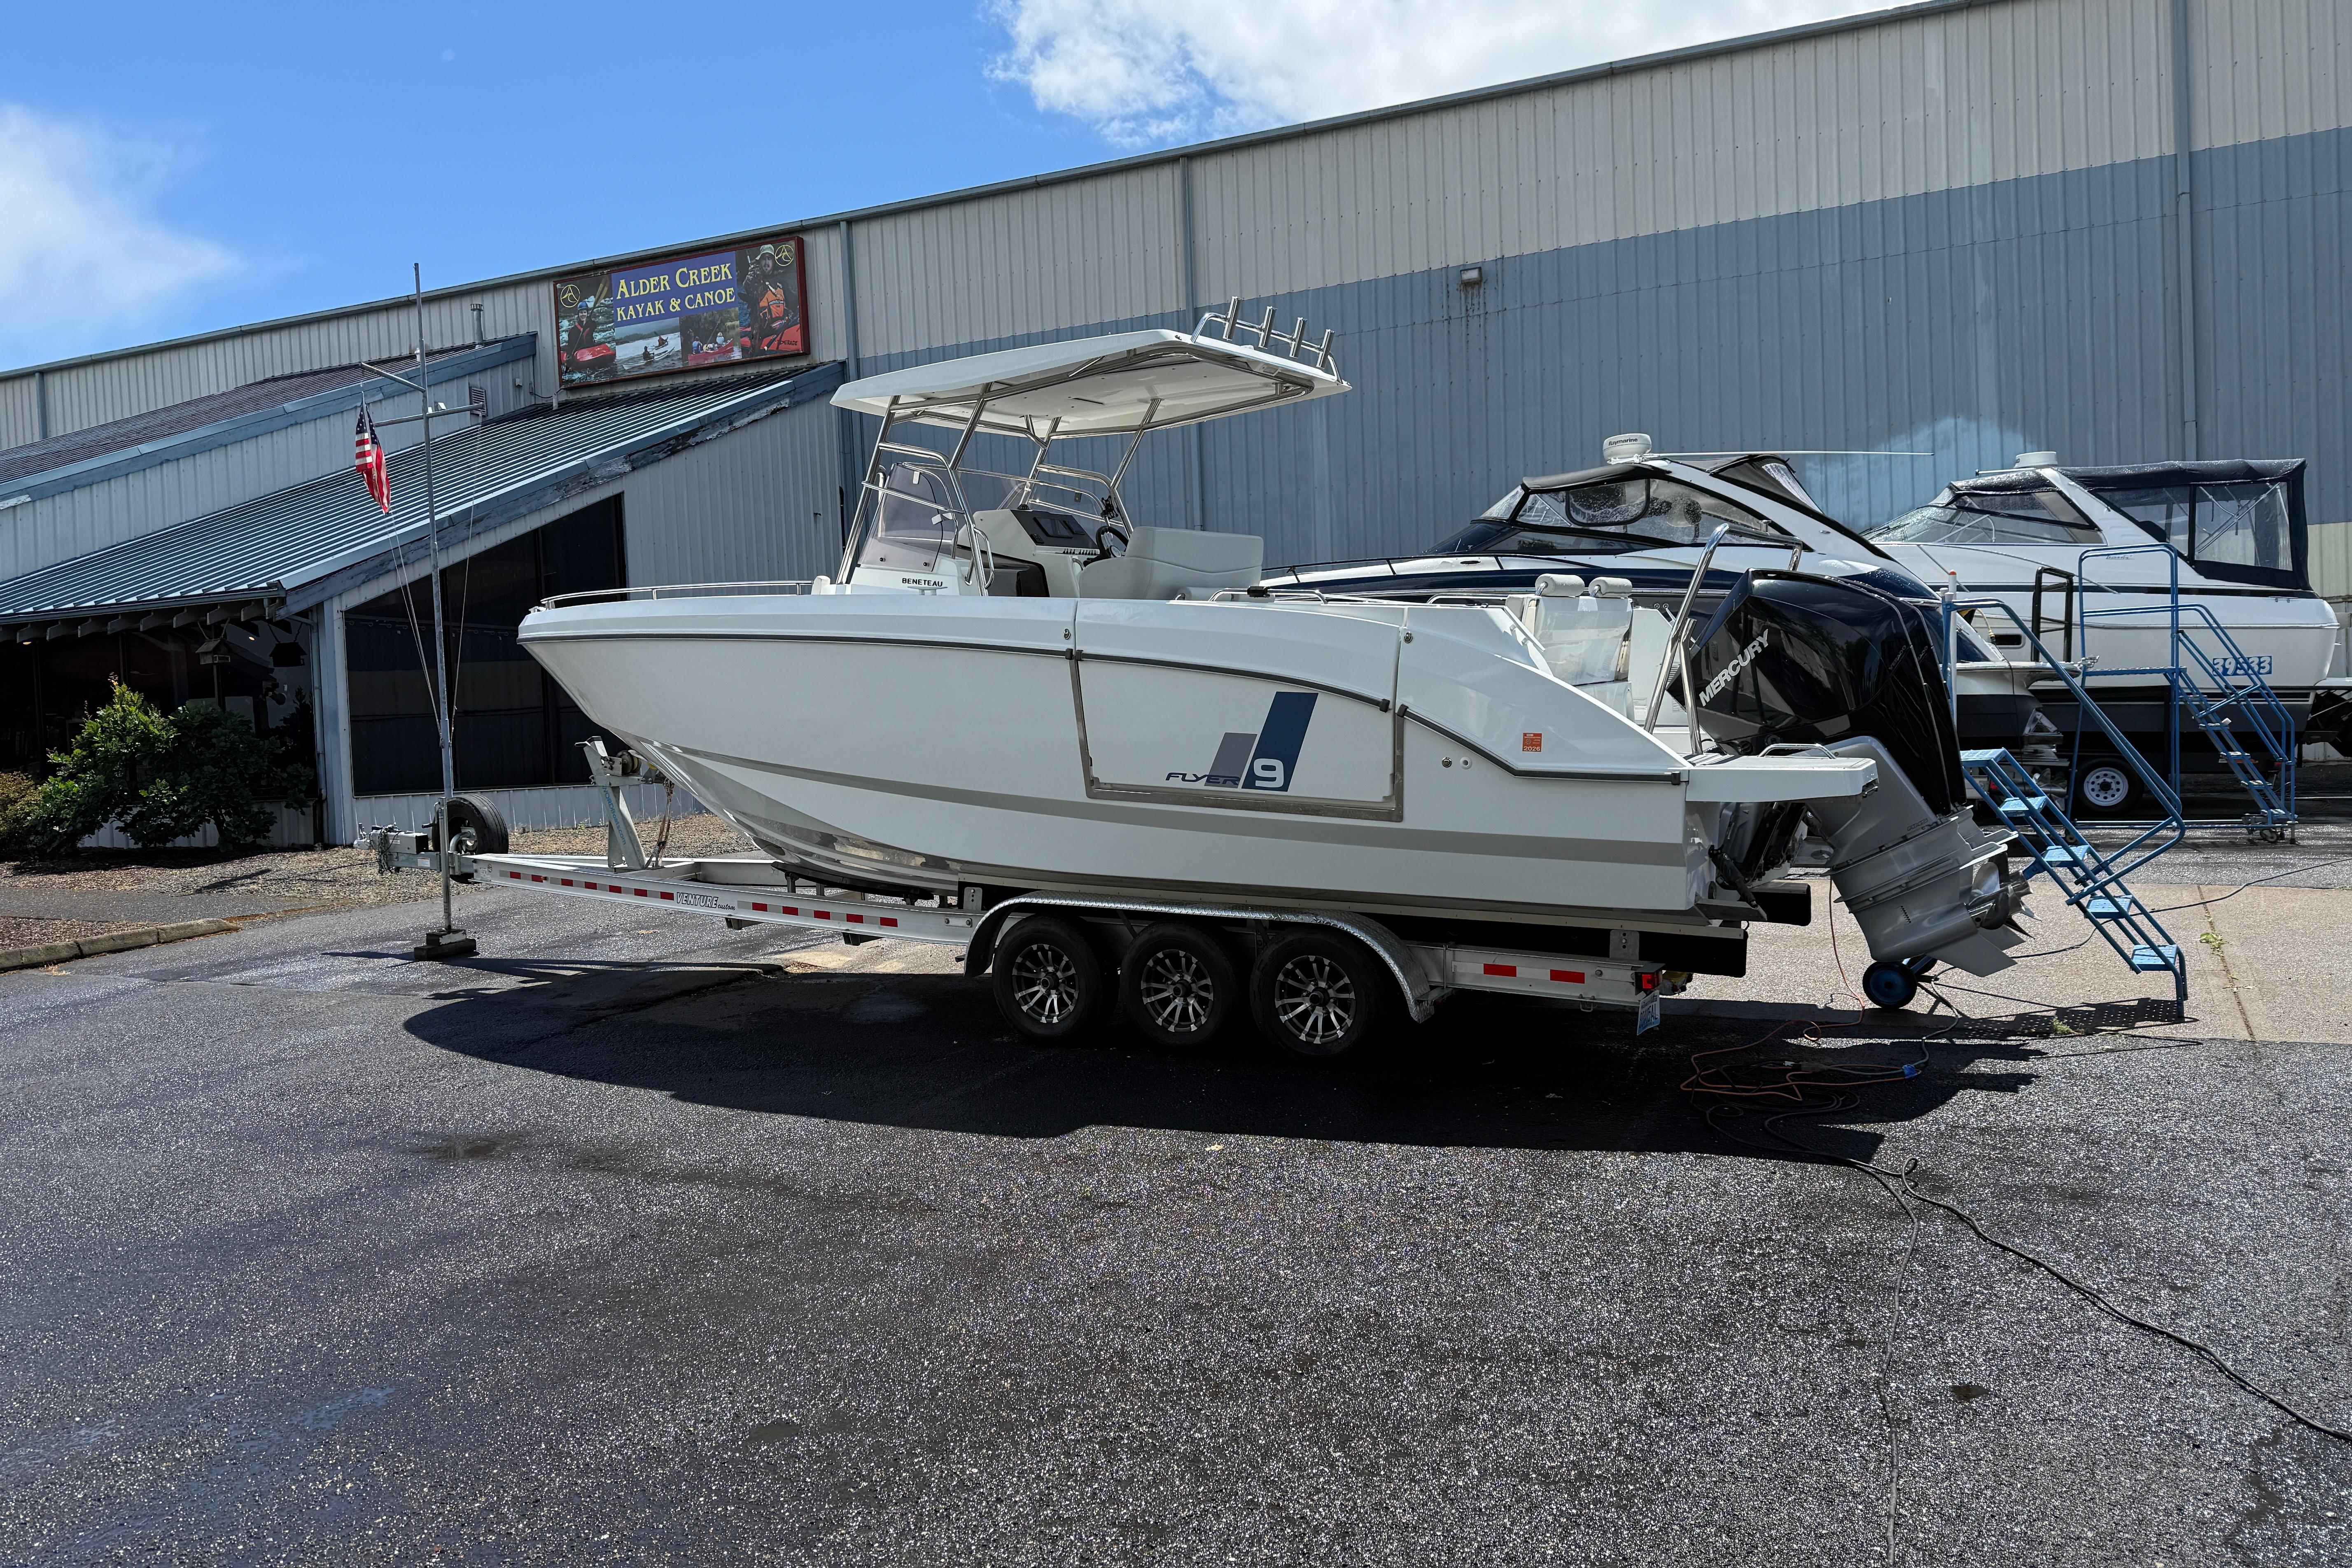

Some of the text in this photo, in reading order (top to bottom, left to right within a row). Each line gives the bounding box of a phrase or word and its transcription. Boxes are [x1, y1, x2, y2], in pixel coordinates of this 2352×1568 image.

[616, 263, 733, 299] ALDER CREEK
[617, 287, 735, 321] KAYAK & CANOE
[1608, 438, 1638, 446] Raymarine
[902, 578, 943, 587] BENETEAU
[1699, 628, 1769, 707] MERCURY
[1165, 758, 1284, 788] FLYER 9
[677, 892, 719, 908] VENTURE
